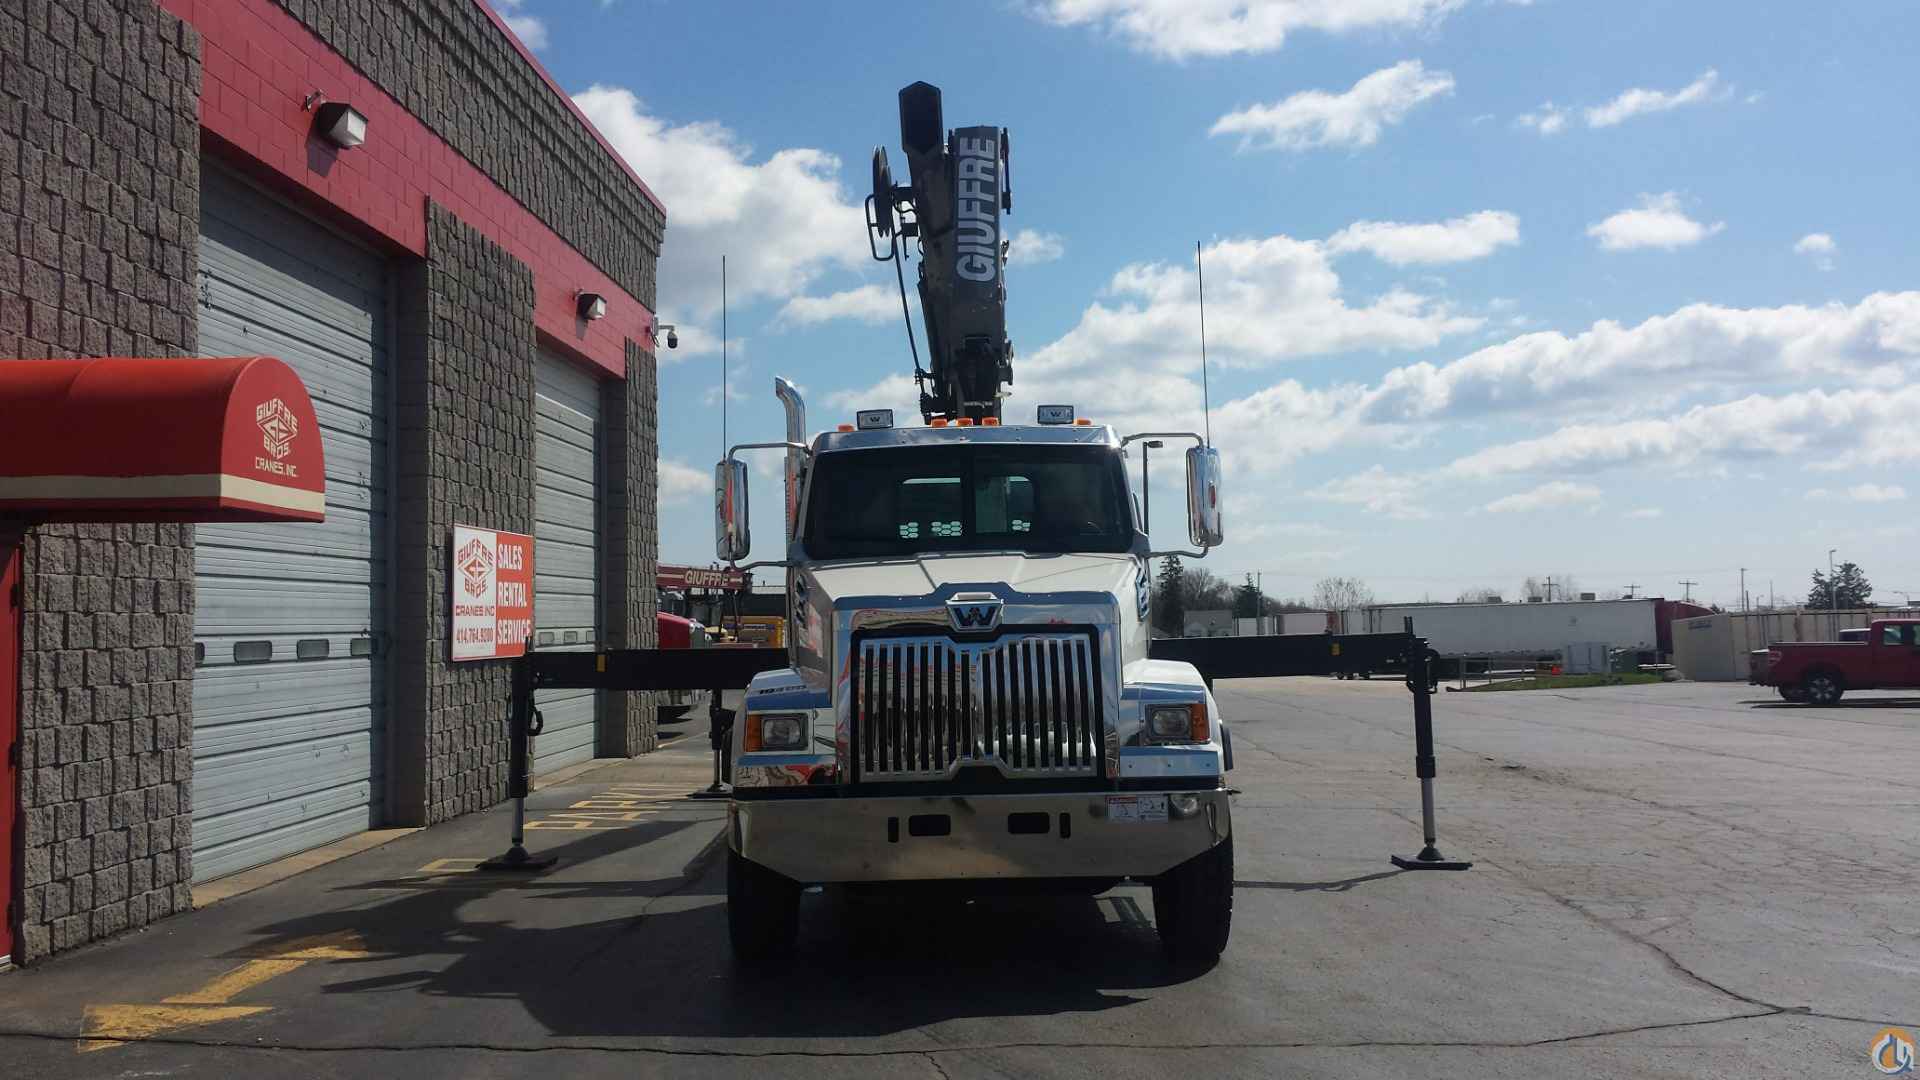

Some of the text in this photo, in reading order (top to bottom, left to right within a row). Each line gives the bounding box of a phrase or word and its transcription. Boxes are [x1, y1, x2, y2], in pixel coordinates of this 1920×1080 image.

[956, 137, 996, 282] GIUFFRE
[256, 398, 298, 433] GIUFFRE
[457, 538, 494, 567] GIUFFRE
[497, 544, 523, 570] SALES
[685, 570, 729, 586] GIUFFRE
[498, 582, 528, 608] RENTAL
[455, 605, 484, 617] CRANES
[497, 619, 532, 646] SERVICE
